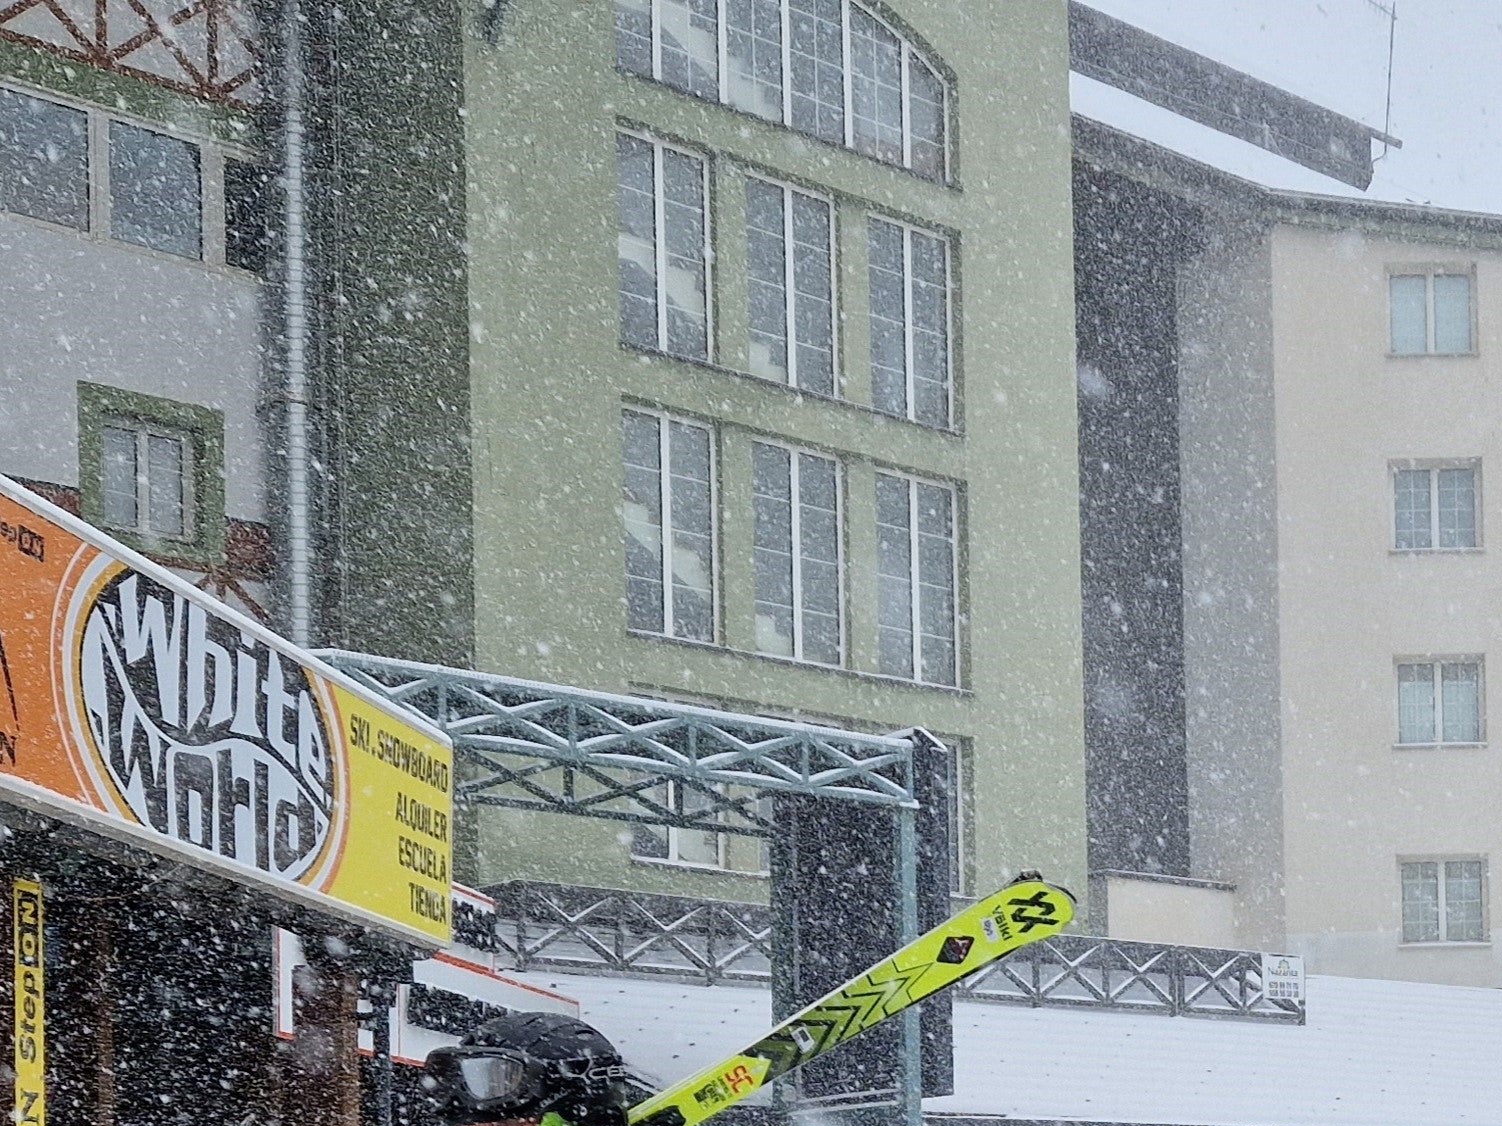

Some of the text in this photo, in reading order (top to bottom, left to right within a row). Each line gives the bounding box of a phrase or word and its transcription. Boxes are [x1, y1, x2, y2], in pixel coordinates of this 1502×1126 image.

[100, 573, 332, 805] White
[81, 604, 330, 881] World
[395, 791, 448, 843] ALQUILER
[398, 835, 448, 884] ESCUELA
[408, 881, 448, 925] TIENDA
[19, 971, 38, 1065] Step
